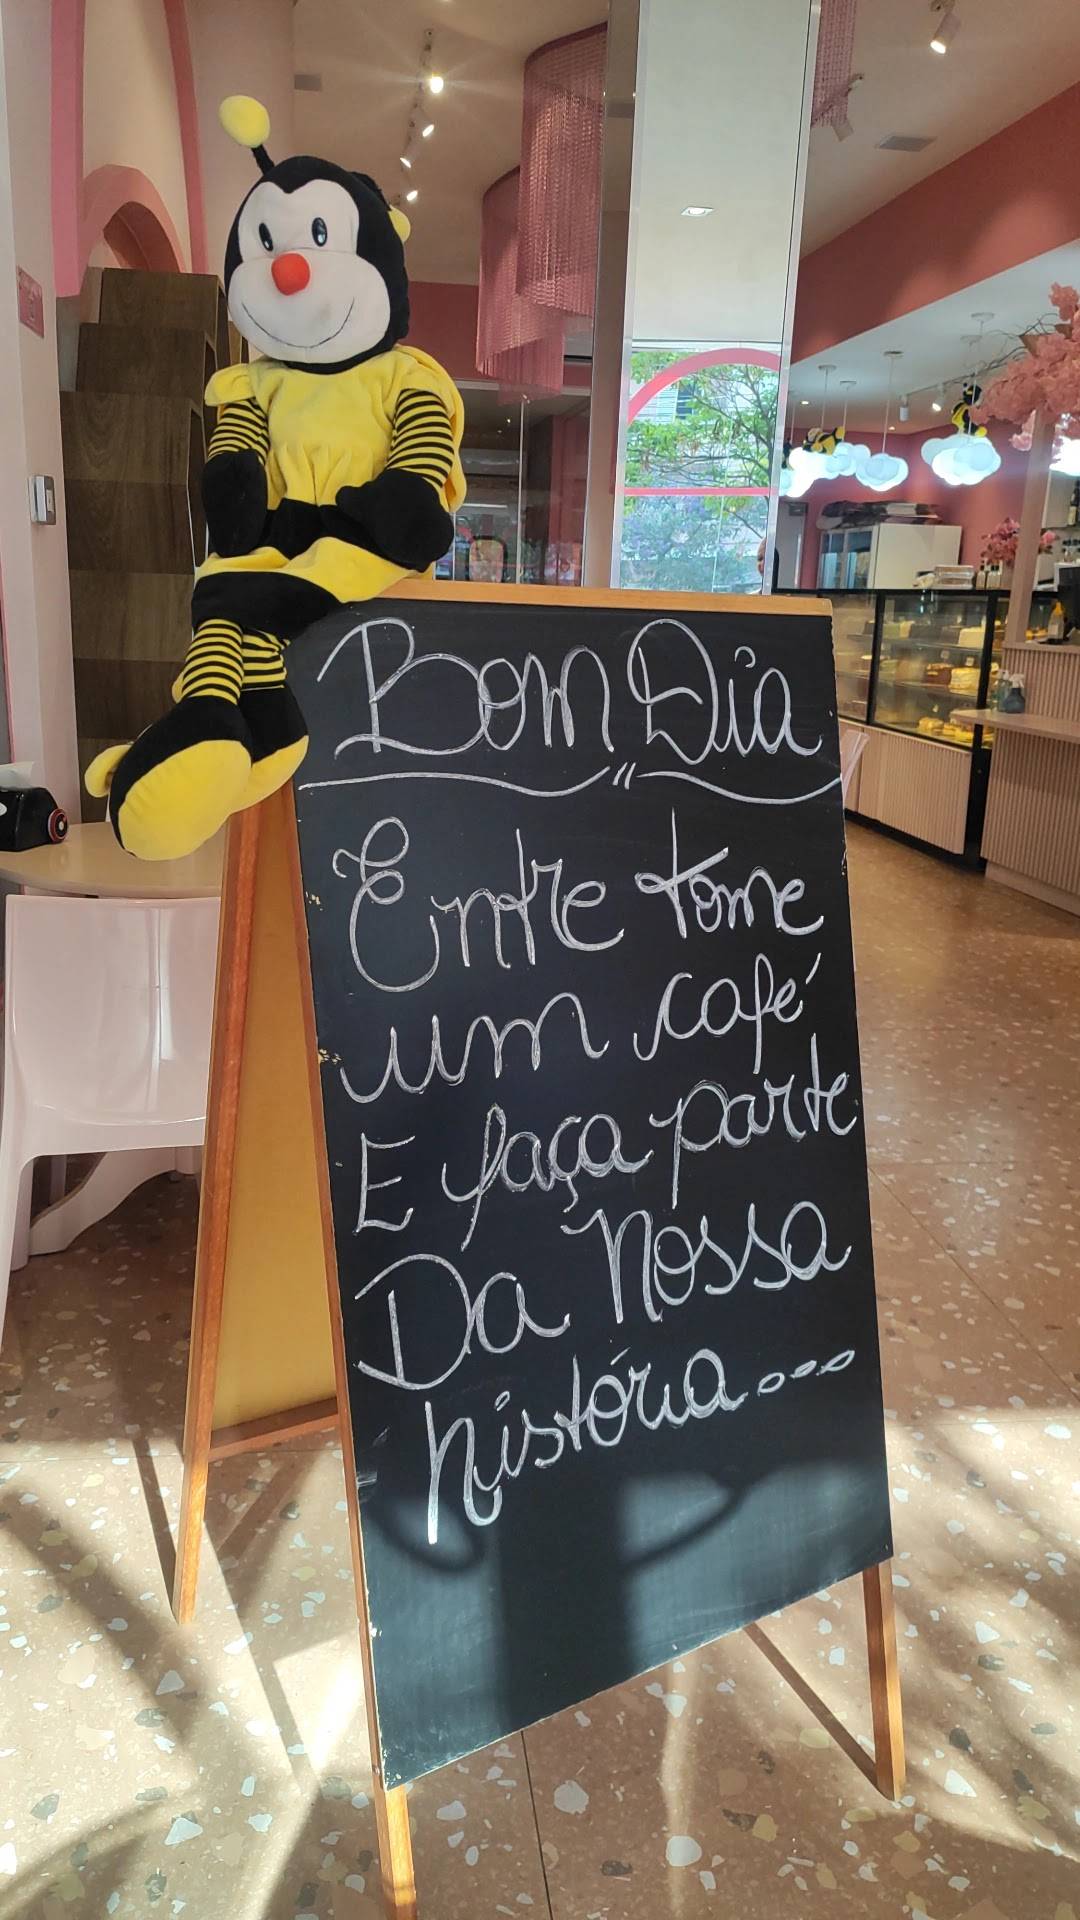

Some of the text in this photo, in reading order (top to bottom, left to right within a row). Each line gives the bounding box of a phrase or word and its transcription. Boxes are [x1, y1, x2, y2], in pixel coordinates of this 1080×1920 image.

[317, 617, 822, 764] Bom Dia
[332, 816, 624, 993] Entre
[340, 953, 821, 1103] um café
[354, 1033, 857, 1252] E faça parte
[354, 1253, 571, 1390] Da
